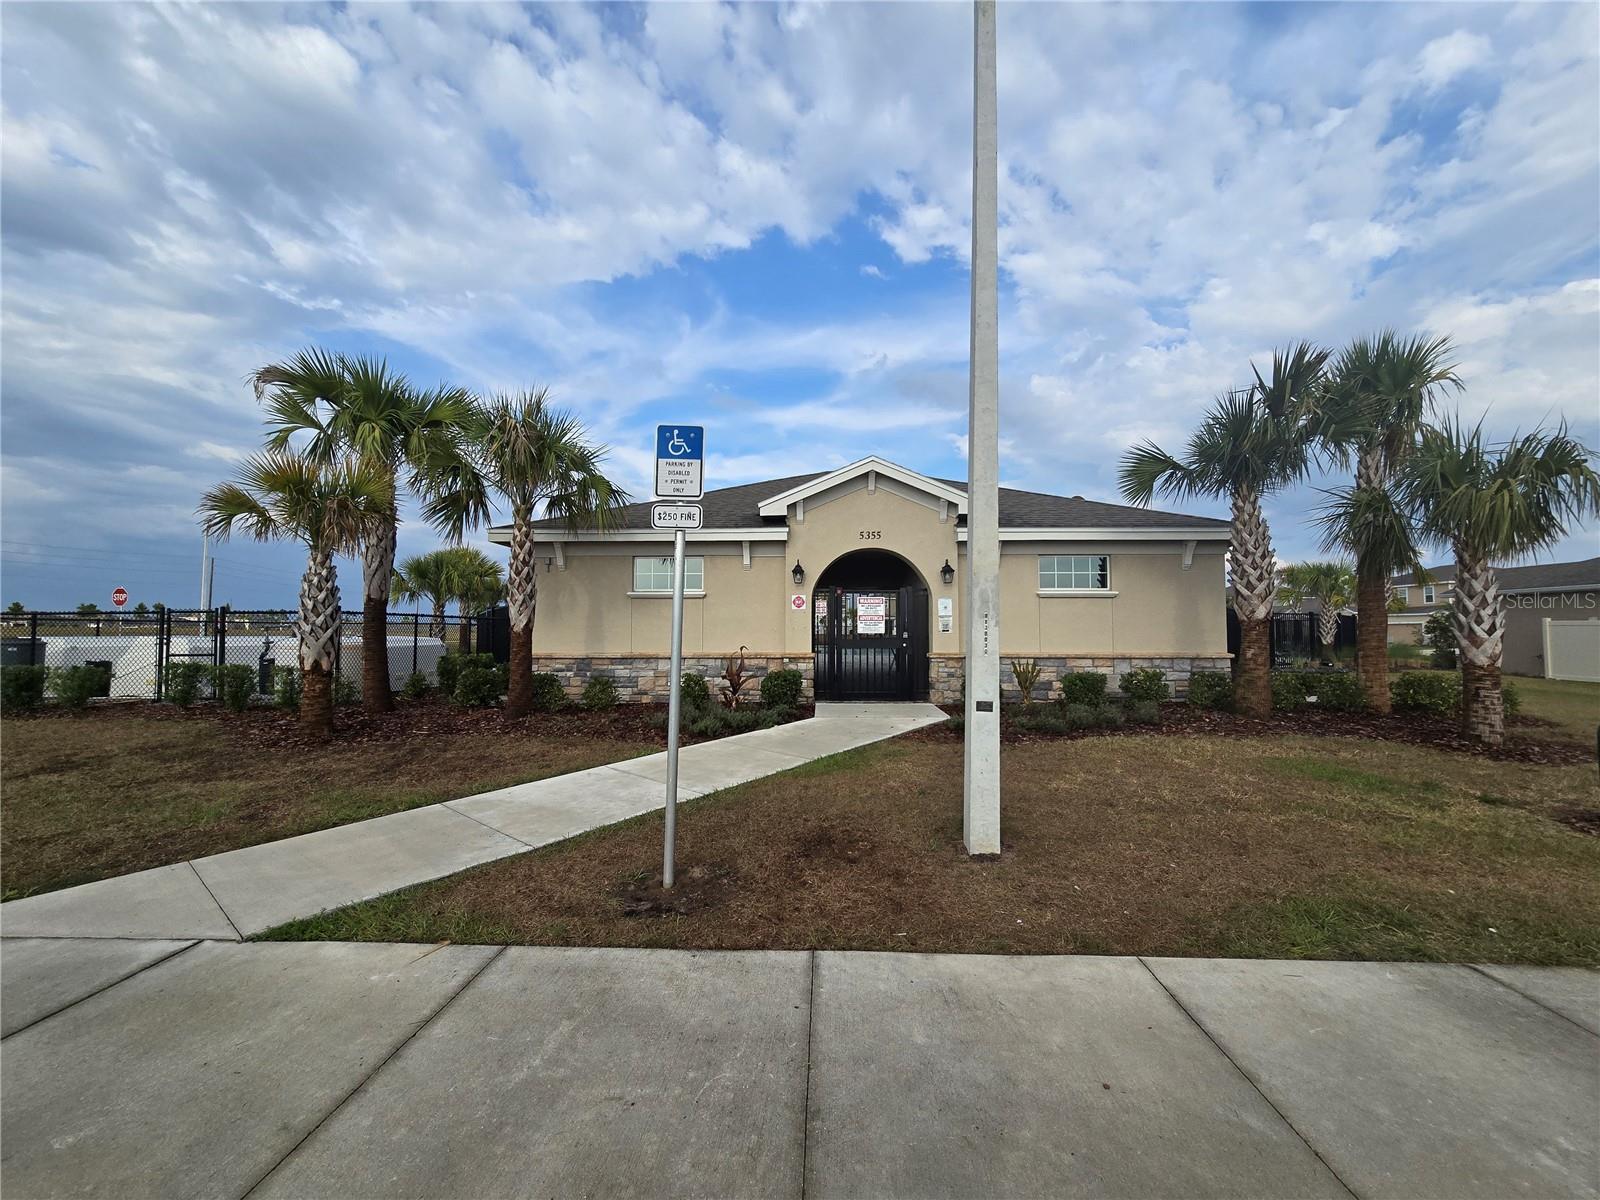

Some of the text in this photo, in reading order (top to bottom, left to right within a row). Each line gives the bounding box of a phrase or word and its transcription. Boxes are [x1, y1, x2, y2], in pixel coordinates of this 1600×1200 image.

[657, 512, 697, 521] $250 FINE
[859, 530, 882, 540] 5355
[113, 593, 127, 601] STOP
